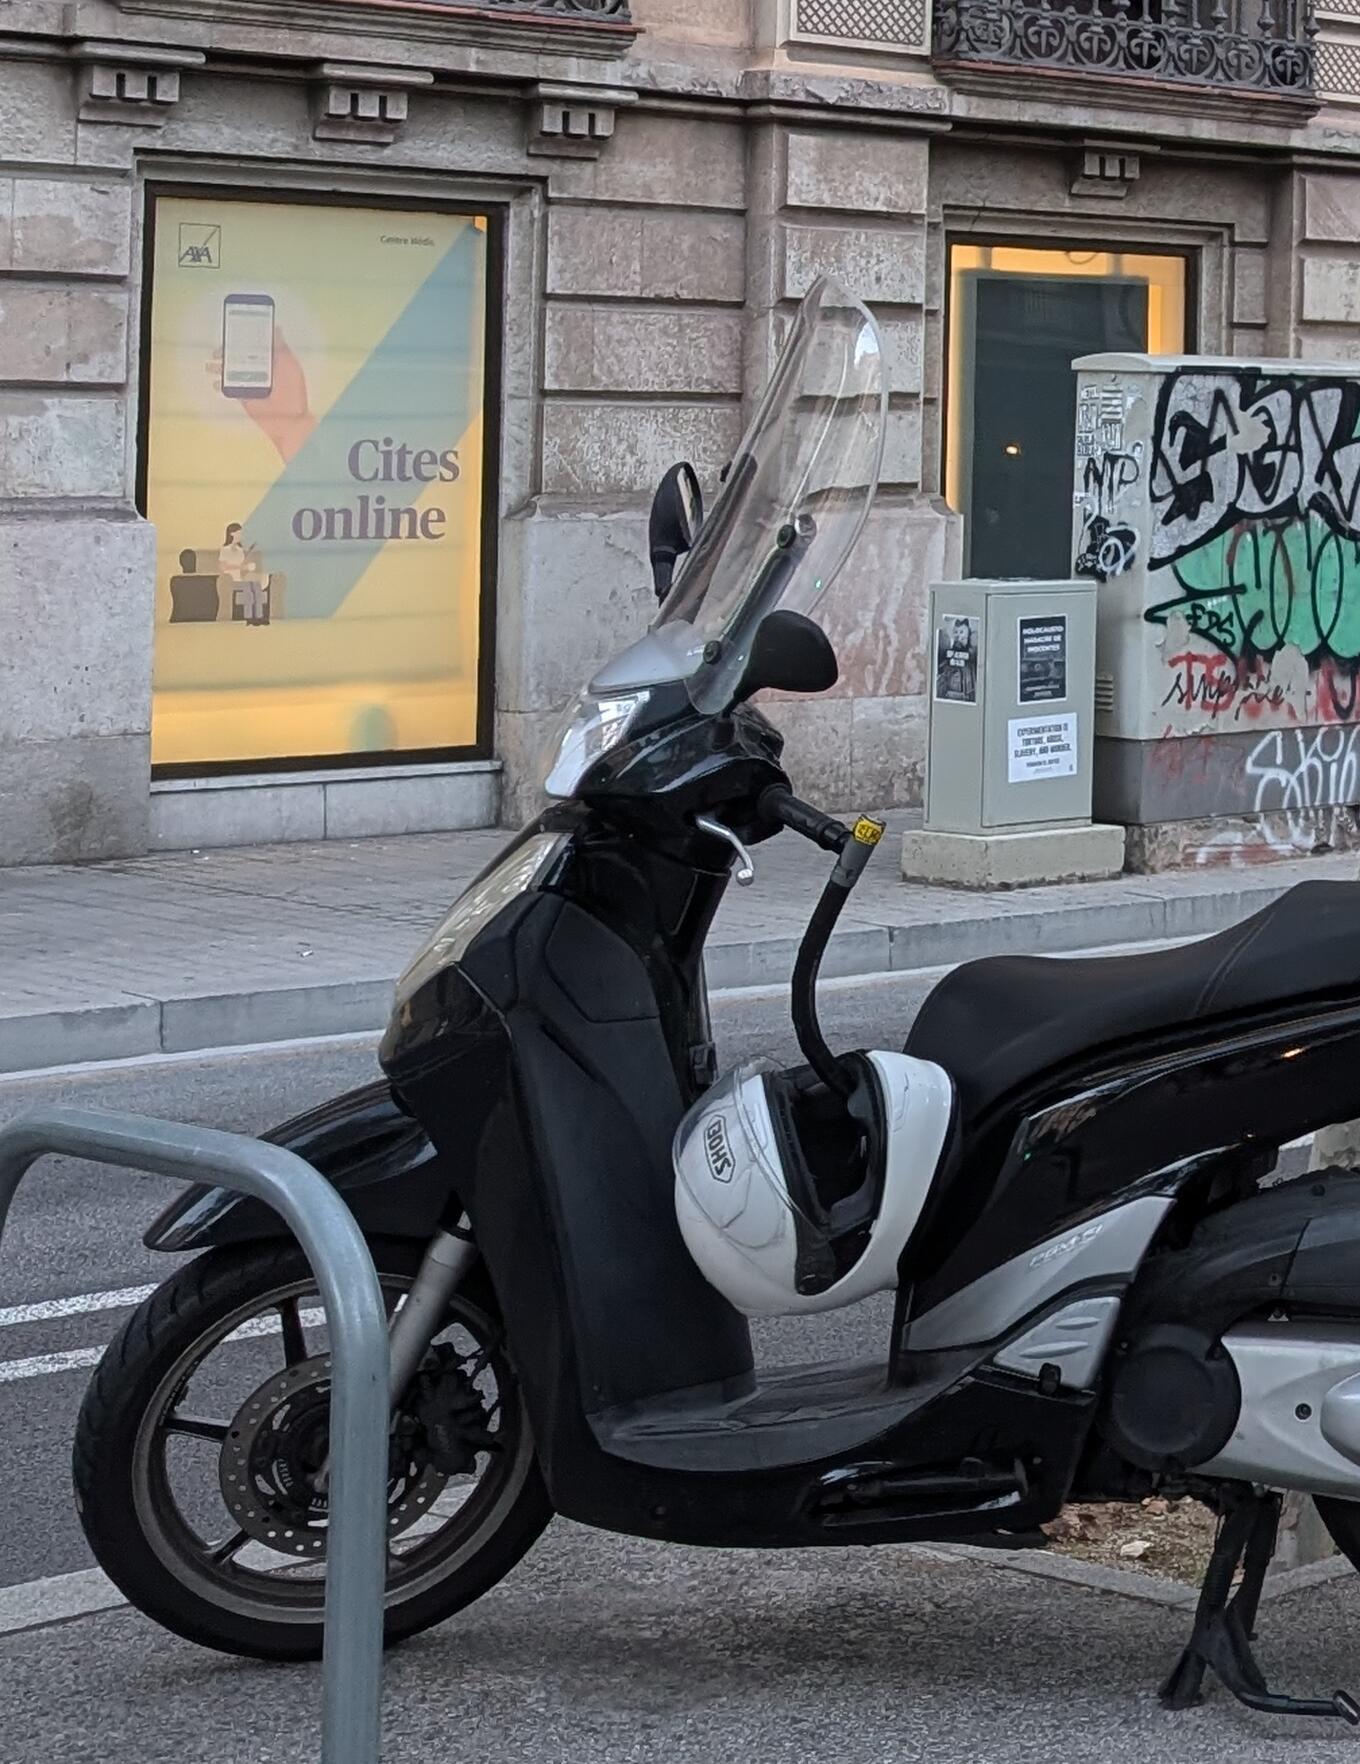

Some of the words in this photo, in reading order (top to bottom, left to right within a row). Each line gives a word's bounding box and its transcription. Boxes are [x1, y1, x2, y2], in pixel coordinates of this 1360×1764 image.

[179, 245, 213, 264] AXA
[347, 436, 461, 482] Cites
[291, 494, 447, 541] online
[706, 1119, 733, 1176] SHOEI
